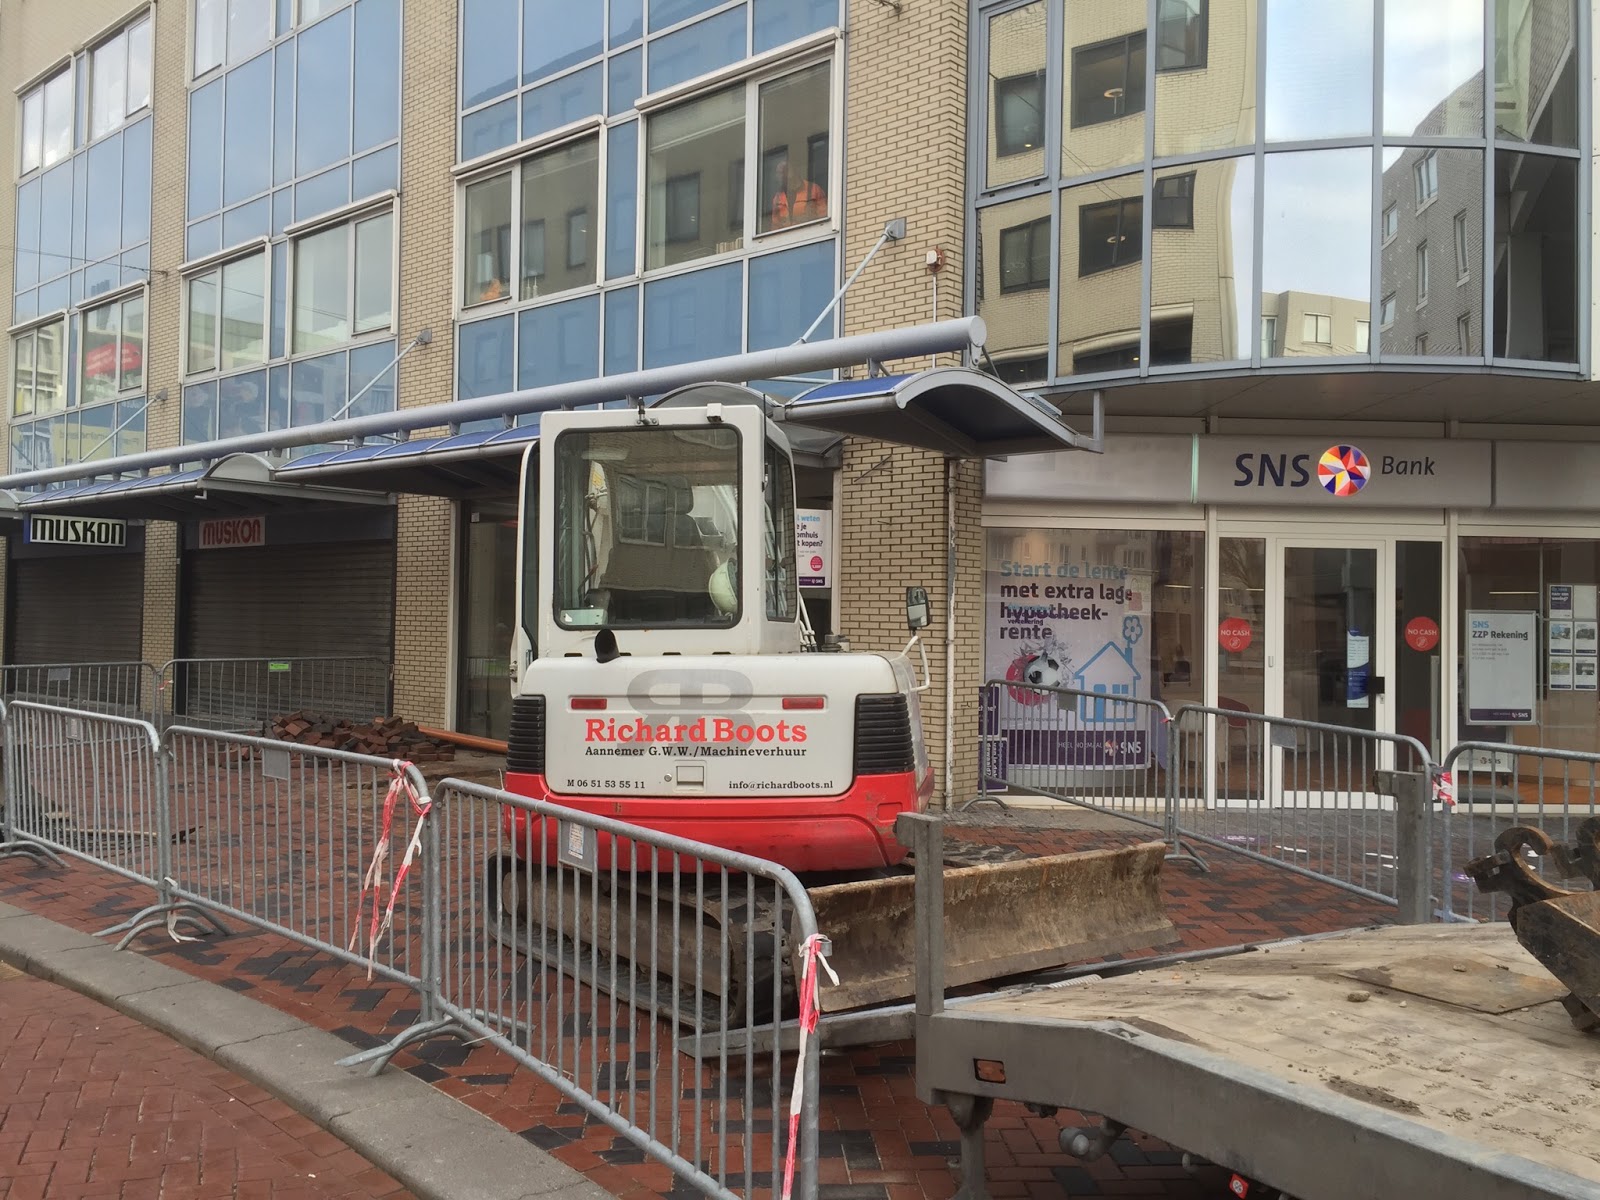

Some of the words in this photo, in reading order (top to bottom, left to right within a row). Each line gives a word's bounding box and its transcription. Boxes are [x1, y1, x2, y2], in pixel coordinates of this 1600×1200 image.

[1234, 453, 1310, 488] SNS
[1381, 455, 1436, 476] Bank
[31, 517, 124, 545] MUSKON
[202, 518, 261, 546] MUSKON
[801, 540, 823, 548] kopen?
[1000, 560, 1052, 577] Start
[1057, 562, 1080, 578] de
[1085, 562, 1128, 580] lente
[1000, 582, 1039, 598] met
[1044, 583, 1094, 600] extra
[1099, 583, 1133, 604] lage
[1472, 620, 1489, 629] SNS
[1000, 624, 1053, 640] rente
[1232, 629, 1250, 637] CASH
[1472, 630, 1489, 639] ZZP
[1490, 630, 1529, 641] Rekening
[585, 717, 708, 743] Richard
[712, 718, 808, 743] Boots
[585, 746, 645, 756] Aannemer
[1120, 741, 1142, 754] SNS
[567, 779, 575, 787] M
[577, 779, 588, 787] 06
[590, 779, 601, 788] 51
[604, 780, 616, 789] 53
[619, 780, 631, 789] 55
[634, 781, 646, 789] 11
[728, 780, 834, 791] info@richardboots.nl
